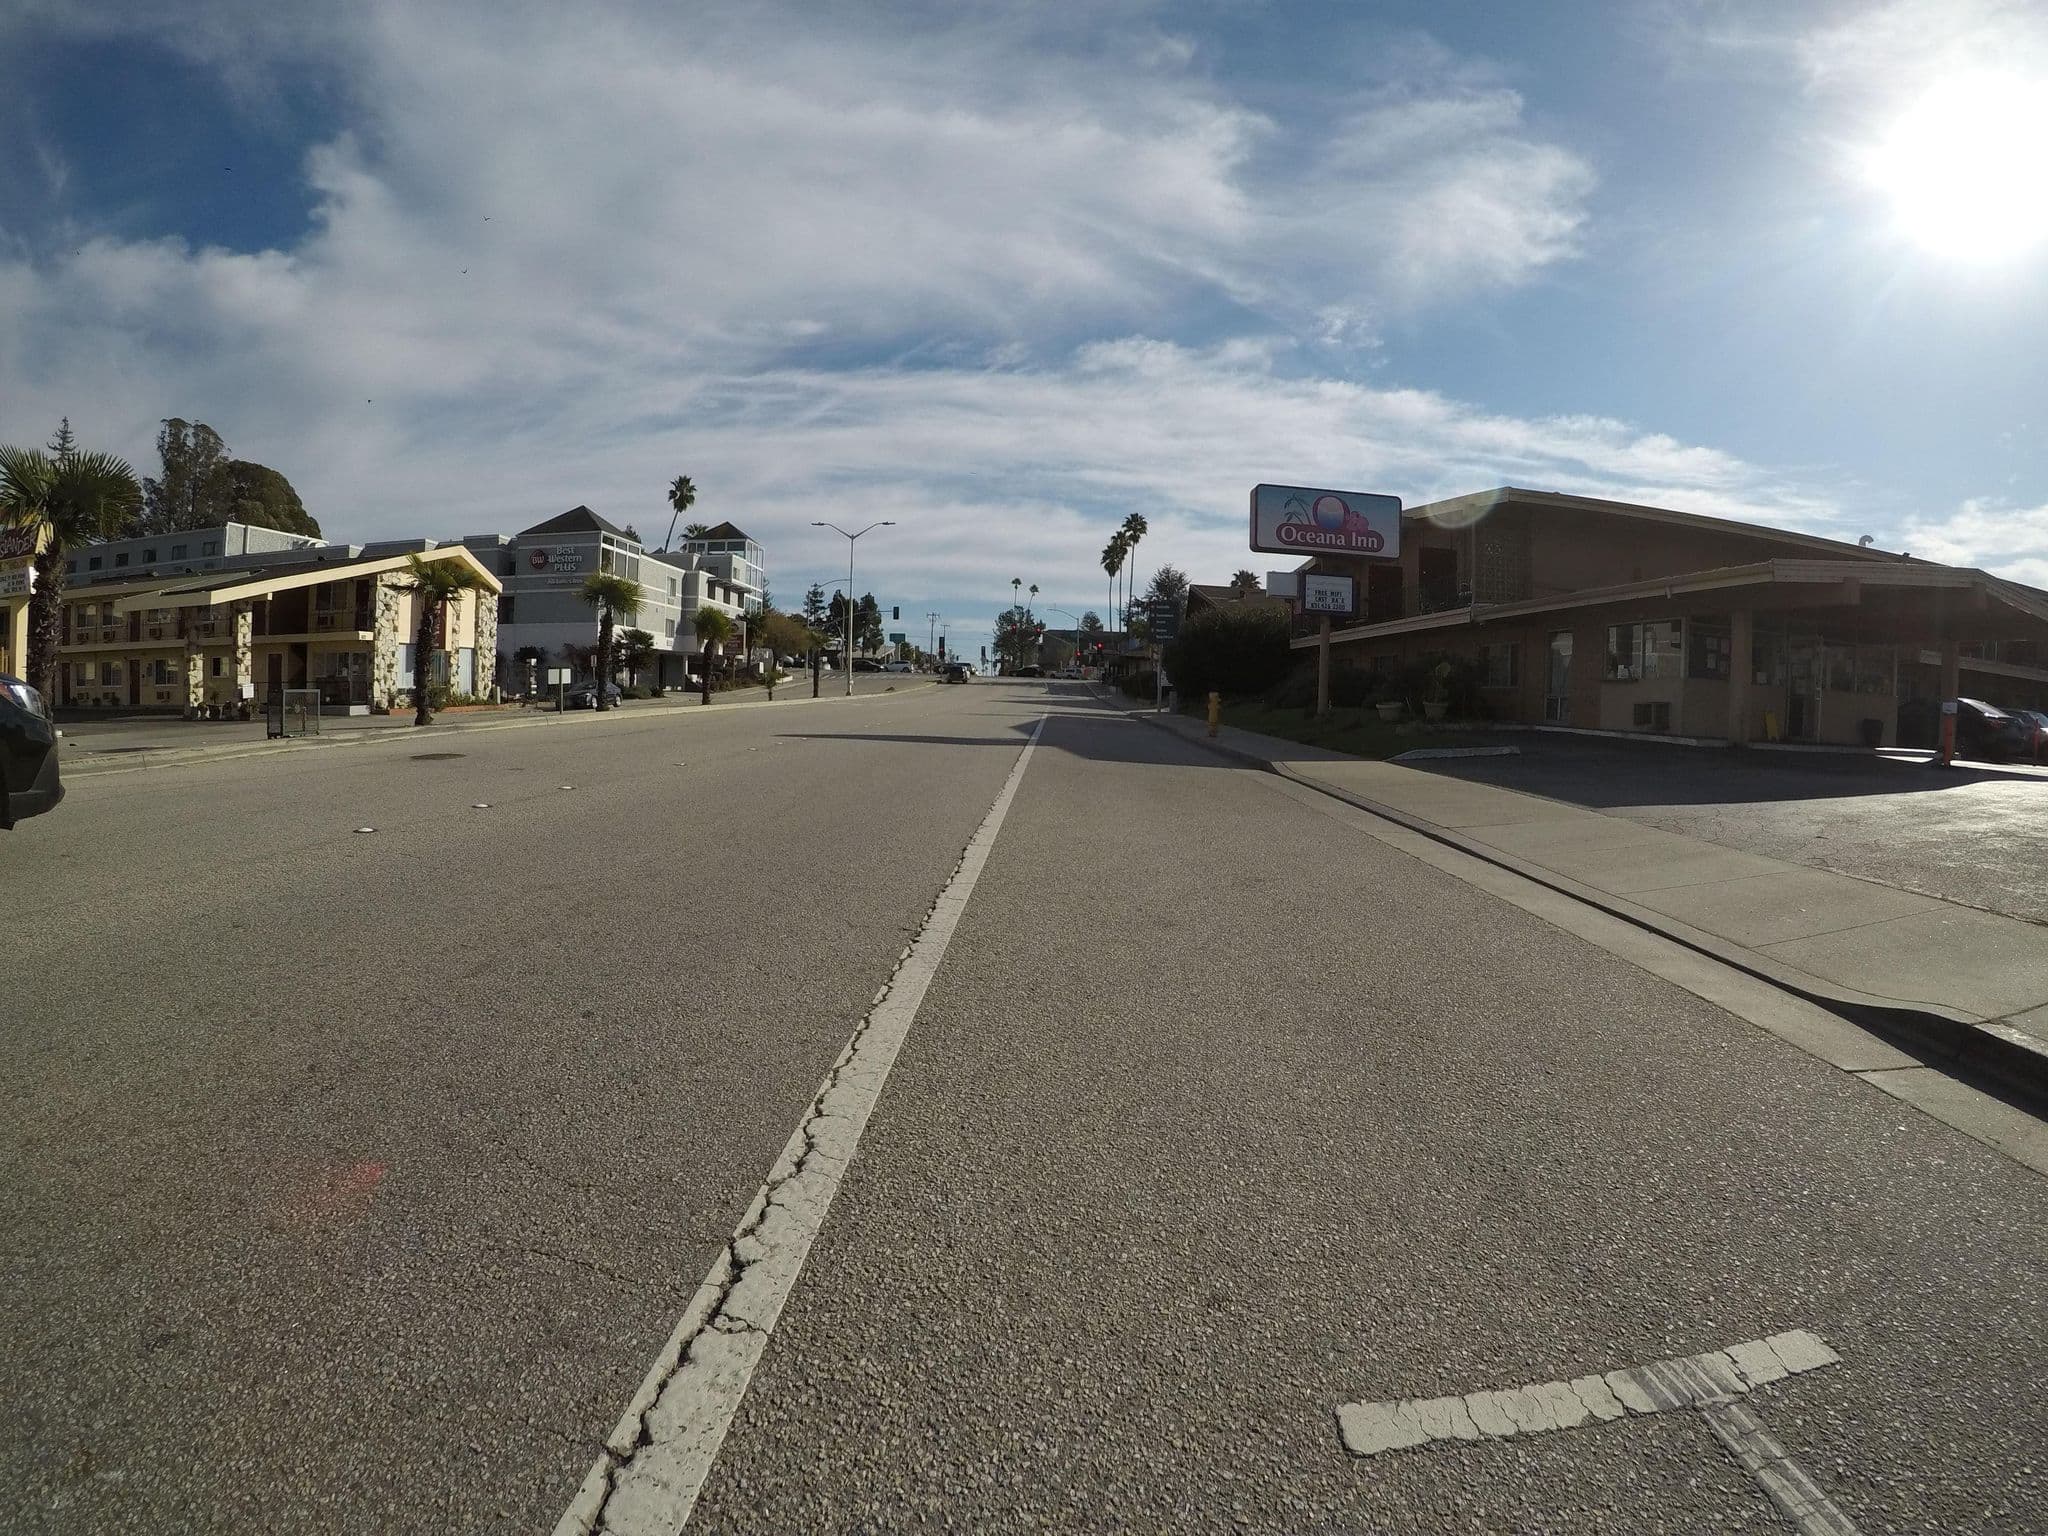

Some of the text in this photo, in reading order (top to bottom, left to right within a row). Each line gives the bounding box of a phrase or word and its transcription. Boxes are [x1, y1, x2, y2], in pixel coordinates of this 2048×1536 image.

[1281, 525, 1378, 549] Oceana Inn
[556, 546, 575, 555] Best
[548, 555, 583, 563] Western
[554, 563, 577, 571] PLUS
